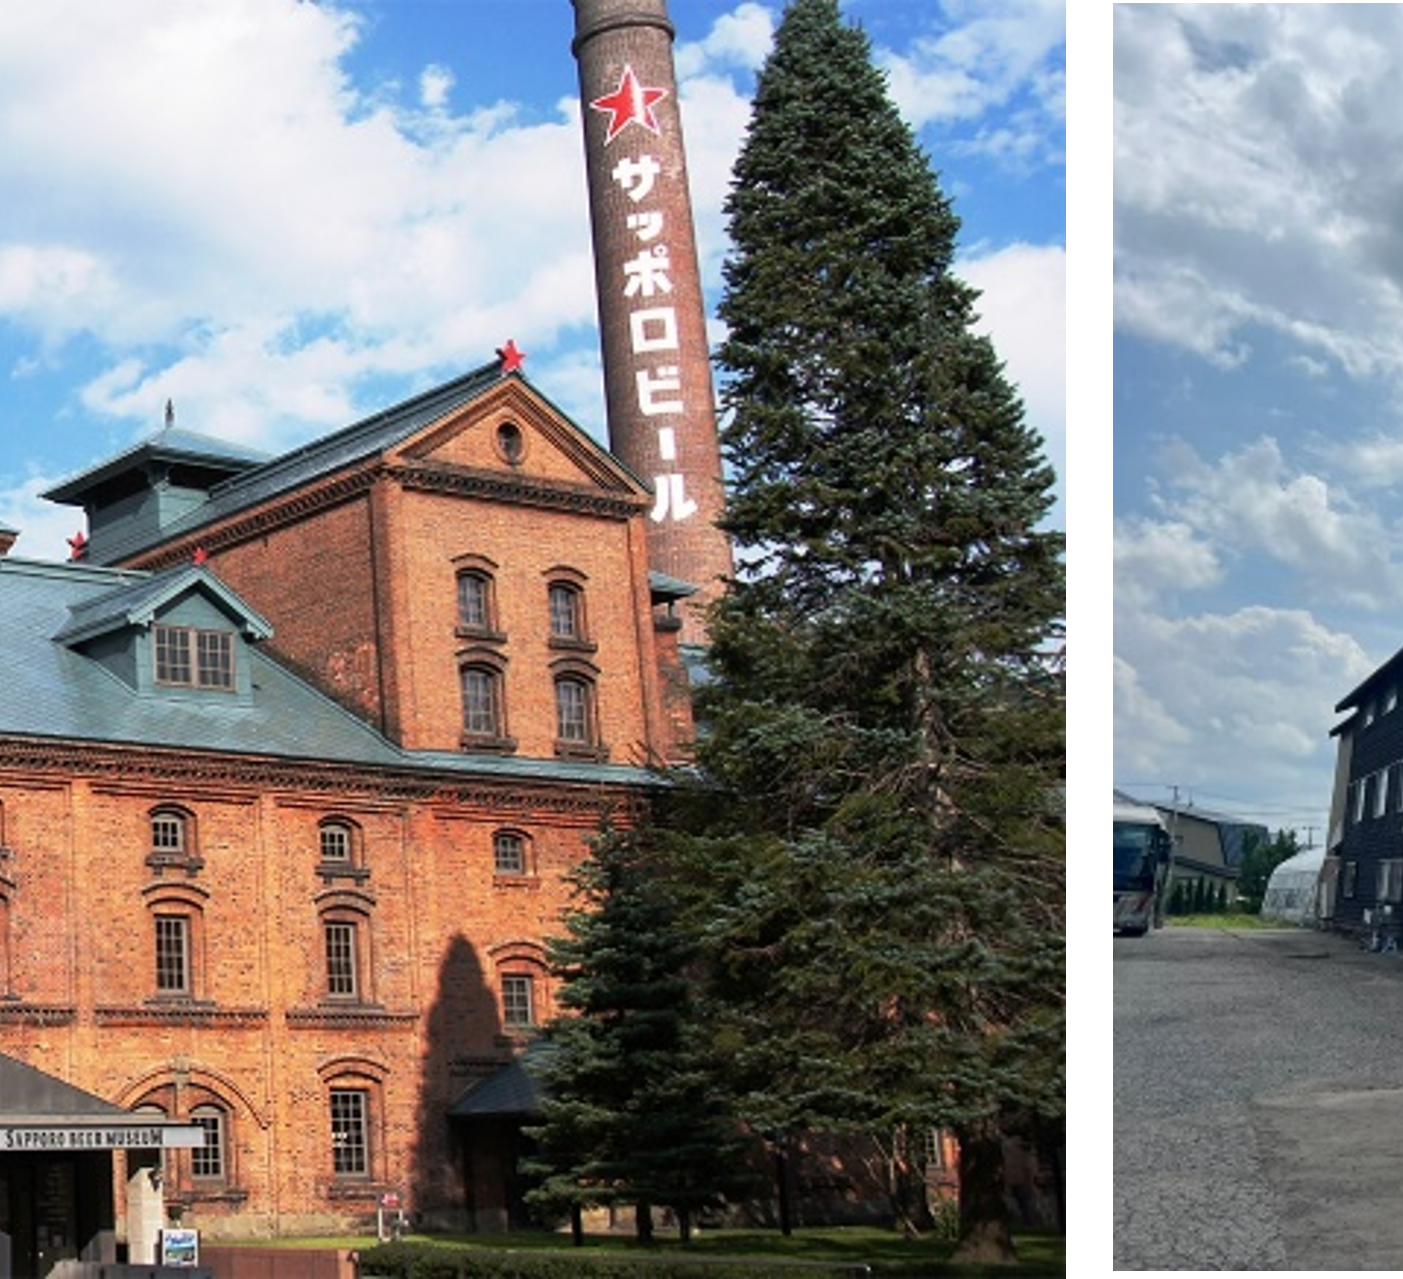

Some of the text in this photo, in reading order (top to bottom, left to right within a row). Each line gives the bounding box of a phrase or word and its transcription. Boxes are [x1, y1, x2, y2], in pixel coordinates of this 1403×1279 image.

[612, 153, 697, 525] サッポロビール
[5, 1128, 163, 1148] SAPPORO BEER MUSEUM
